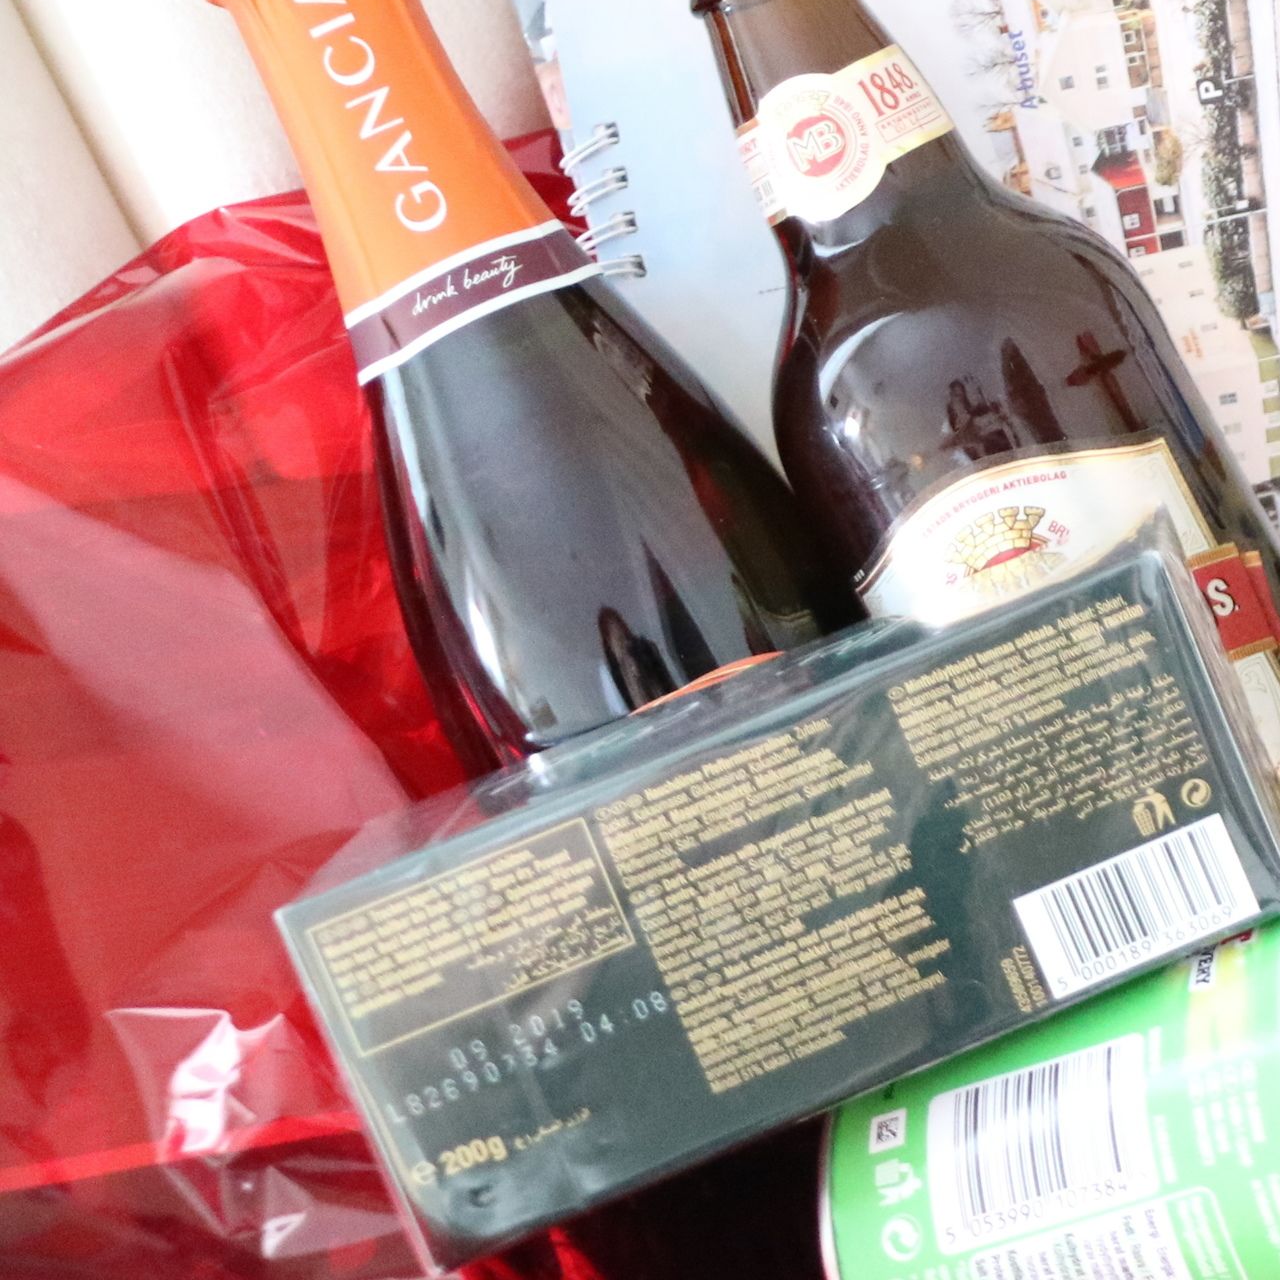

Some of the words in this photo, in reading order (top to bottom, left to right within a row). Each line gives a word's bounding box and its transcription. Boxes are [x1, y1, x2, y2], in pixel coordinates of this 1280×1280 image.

[411, 282, 456, 318] drink
[463, 253, 523, 289] beauty
[1001, 468, 1068, 492] AKTIEBOLAG
[1057, 977, 1068, 990] 5
[1079, 940, 1155, 979] 000189
[1162, 905, 1235, 943] 363069
[438, 1132, 508, 1177] 200g
